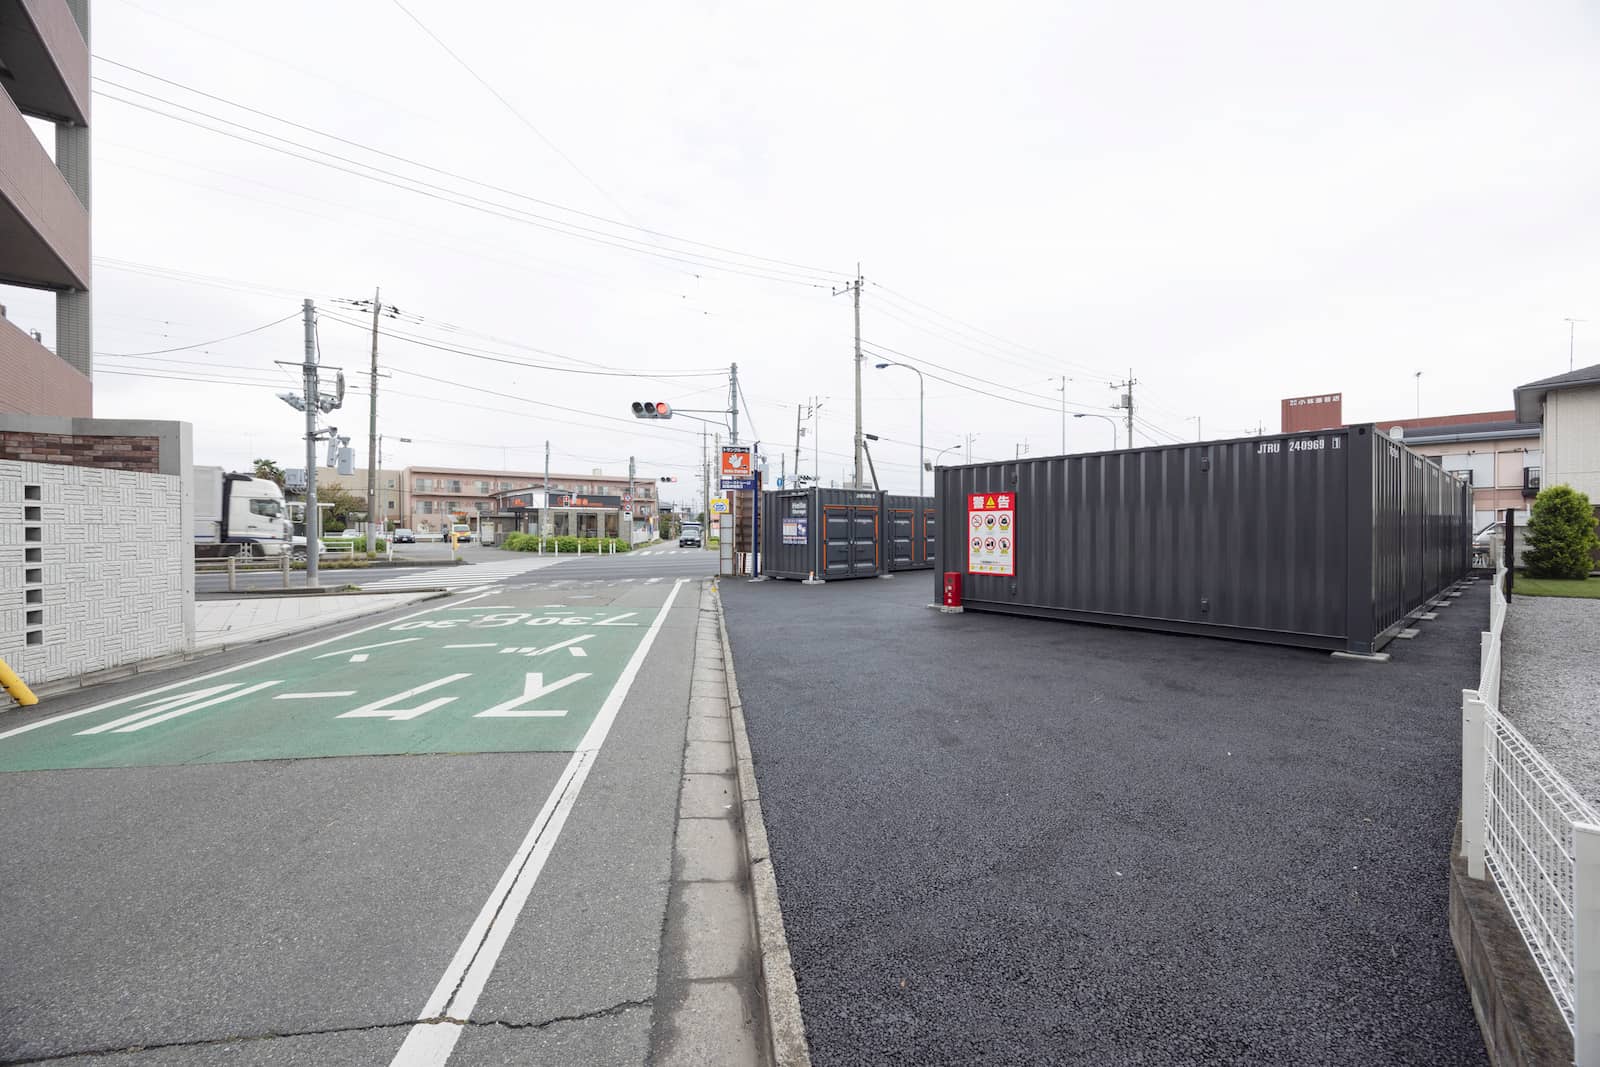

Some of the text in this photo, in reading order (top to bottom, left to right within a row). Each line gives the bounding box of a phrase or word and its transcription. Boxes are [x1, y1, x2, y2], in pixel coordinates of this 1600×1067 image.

[1257, 443, 1280, 454] JTRU
[1289, 439, 1325, 452] 240969
[311, 633, 597, 662] ゾーン
[72, 672, 594, 737] スクール
